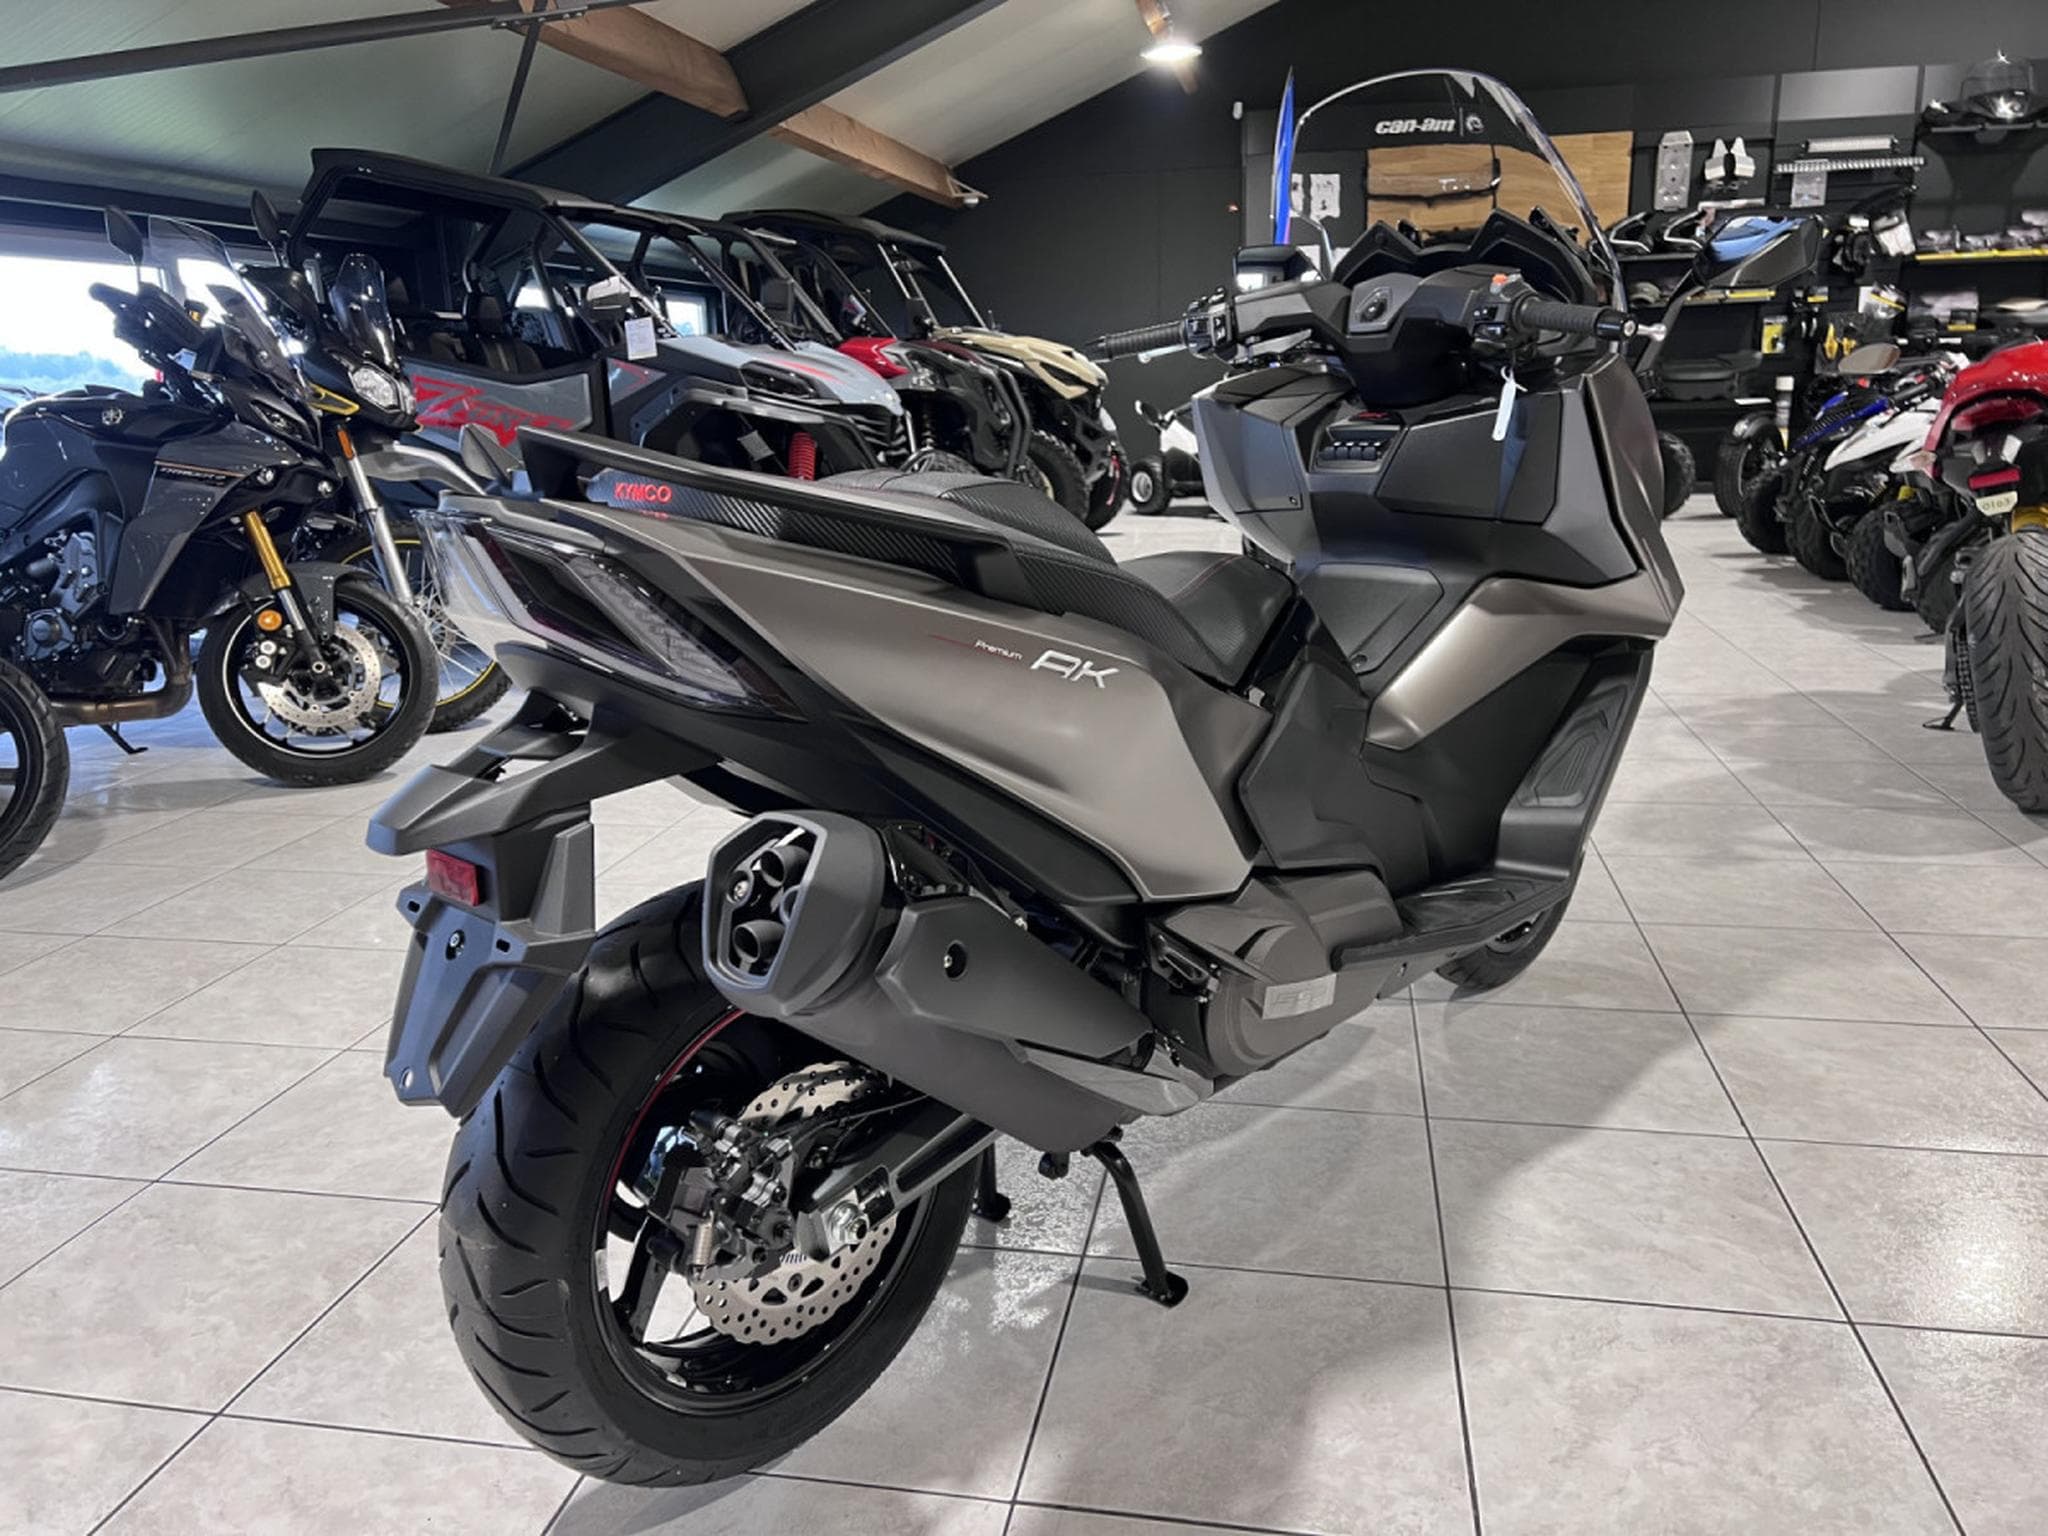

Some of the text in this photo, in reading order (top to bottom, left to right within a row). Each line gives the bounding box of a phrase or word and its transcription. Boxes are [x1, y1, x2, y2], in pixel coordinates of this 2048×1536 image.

[1375, 118, 1456, 134] can-am
[614, 482, 672, 504] KYMCO
[974, 639, 1120, 689] Premium AK
